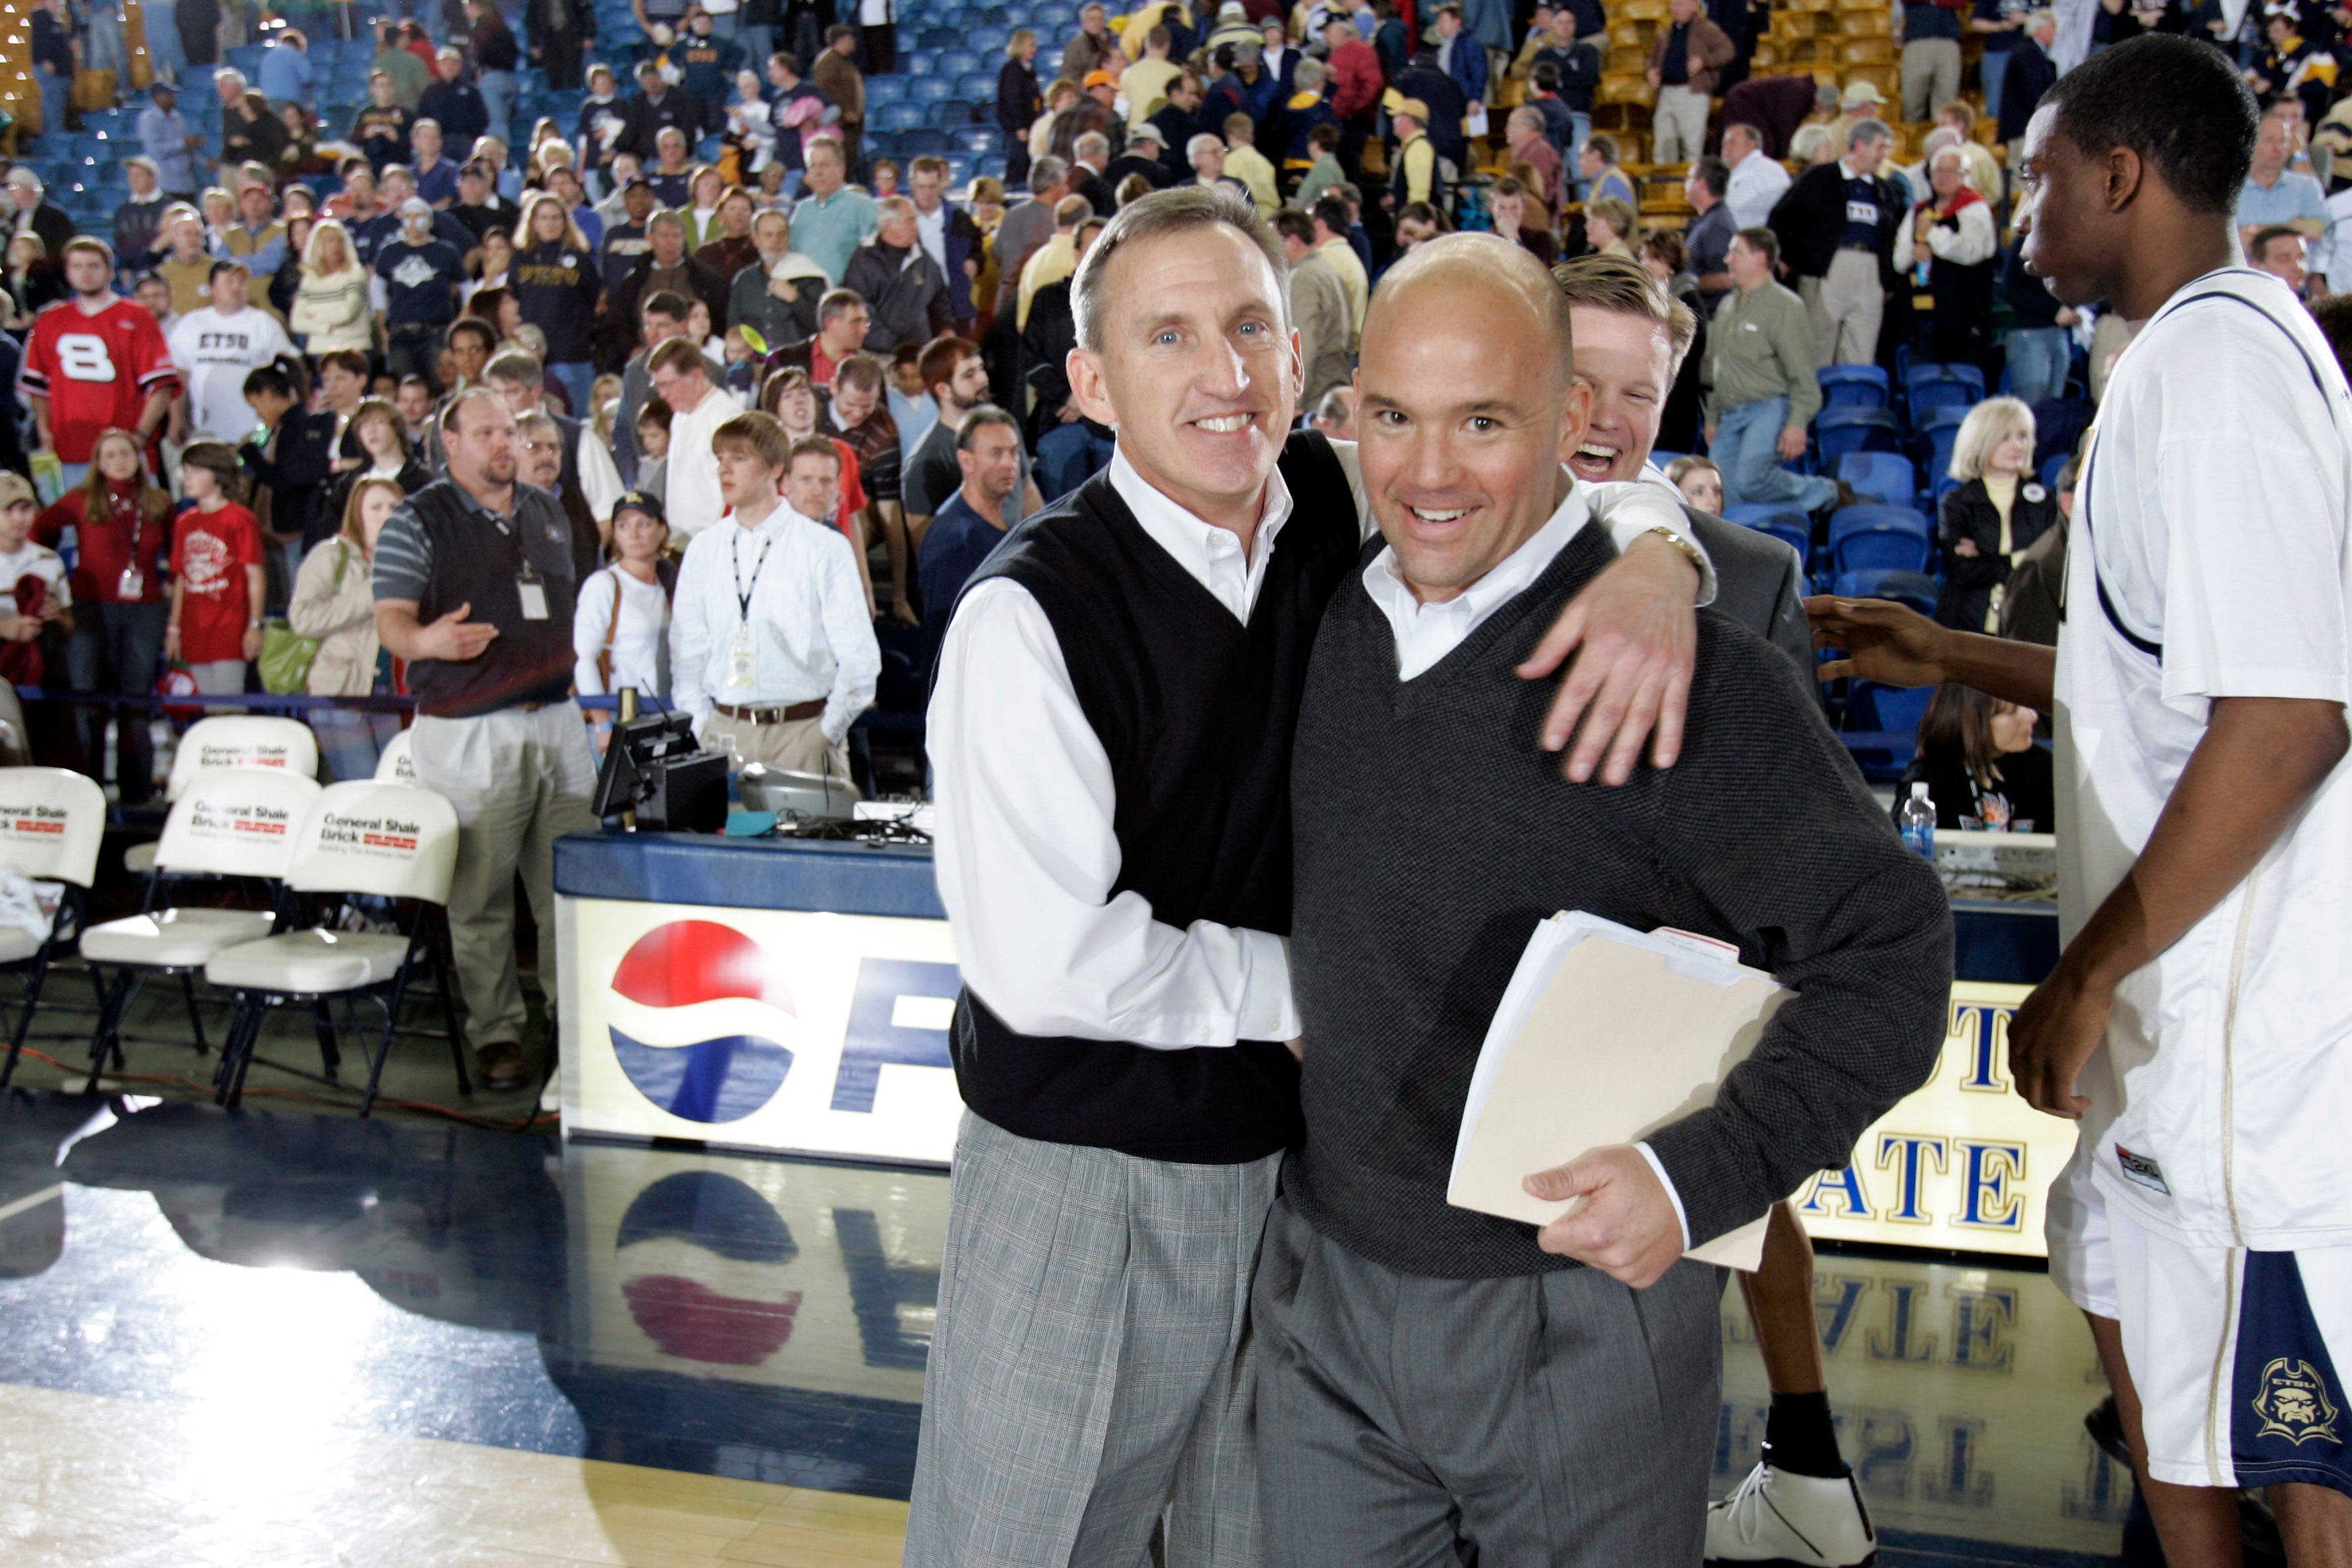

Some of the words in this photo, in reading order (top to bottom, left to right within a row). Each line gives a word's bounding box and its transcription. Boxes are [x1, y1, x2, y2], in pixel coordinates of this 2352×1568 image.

[199, 333, 249, 350] ETSU
[55, 333, 117, 383] 8
[324, 812, 382, 830] General
[385, 818, 420, 834] Shale
[320, 826, 358, 843] Brick
[2271, 1377, 2317, 1389] ETSU
